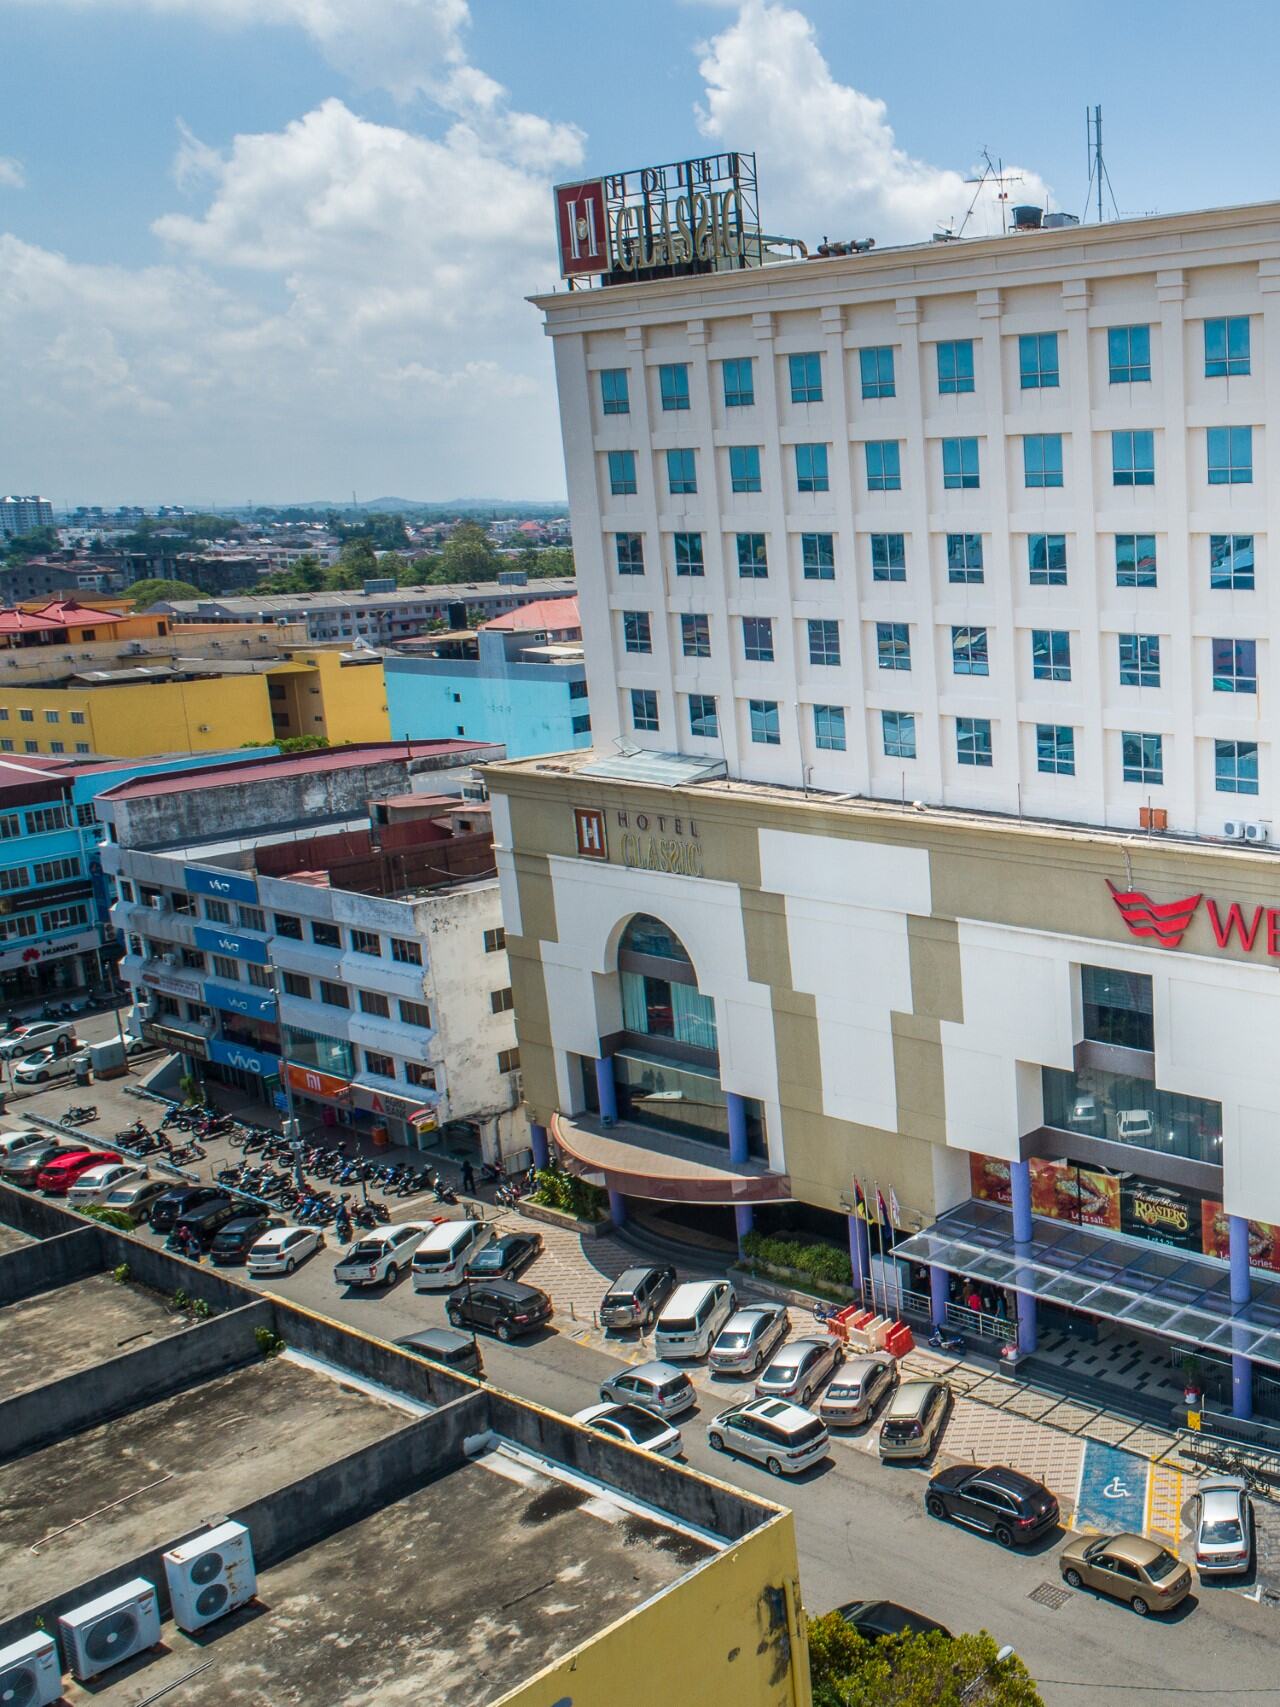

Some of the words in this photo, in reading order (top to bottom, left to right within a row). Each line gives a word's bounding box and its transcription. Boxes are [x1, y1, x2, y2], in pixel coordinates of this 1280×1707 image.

[613, 155, 738, 199] HOTEL
[616, 188, 744, 272] CLASSIC
[617, 811, 700, 838] HOTEL
[209, 880, 230, 892] vivo
[218, 939, 239, 952] vivo
[227, 1051, 261, 1073] vivo
[1134, 1199, 1189, 1231] ROASTERS
